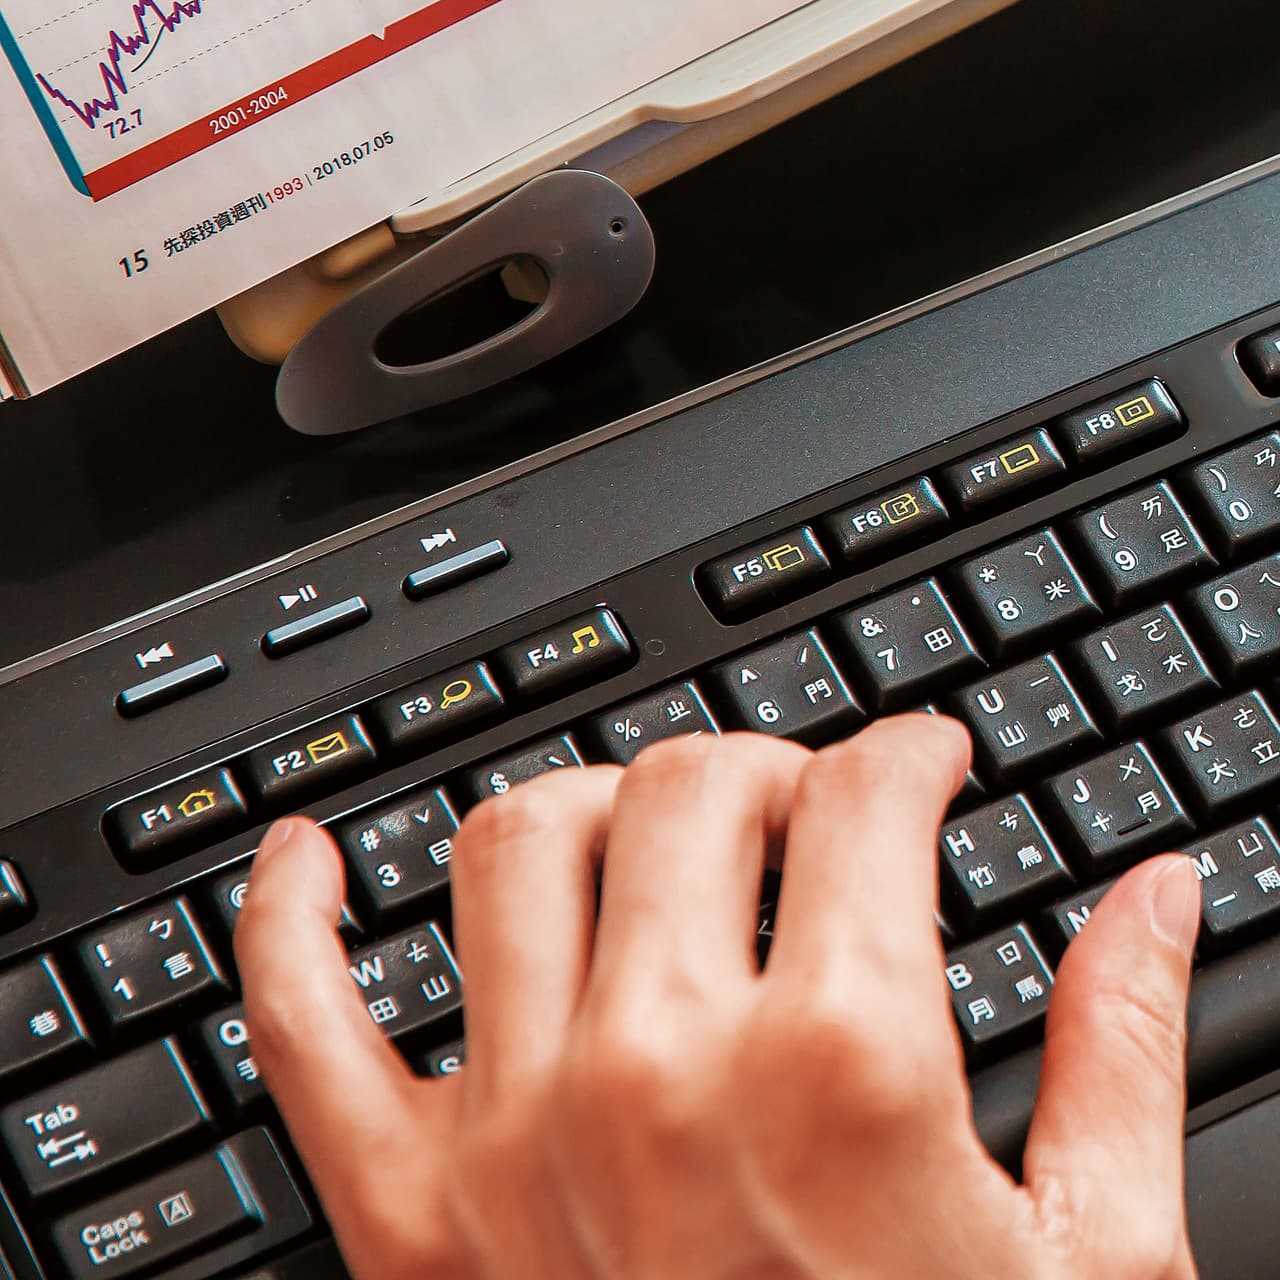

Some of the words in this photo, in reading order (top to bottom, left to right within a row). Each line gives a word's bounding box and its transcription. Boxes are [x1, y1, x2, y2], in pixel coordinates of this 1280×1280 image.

[103, 108, 144, 140] 72.7
[209, 87, 289, 135] 2001-2004
[118, 248, 149, 278] 15
[1086, 413, 1117, 436] F8
[970, 461, 1000, 485] F7
[851, 509, 883, 534] F6
[732, 557, 764, 583] F5
[527, 643, 559, 668] F4
[400, 695, 432, 721] F3
[976, 688, 1003, 716] U
[272, 750, 305, 776] F2
[140, 803, 172, 830] F1
[377, 862, 401, 888] 3
[349, 955, 385, 988] W
[368, 996, 399, 1025] 田
[24, 1103, 79, 1136] Tab
[81, 1210, 145, 1248] Caps
[87, 1229, 151, 1266] Lock
